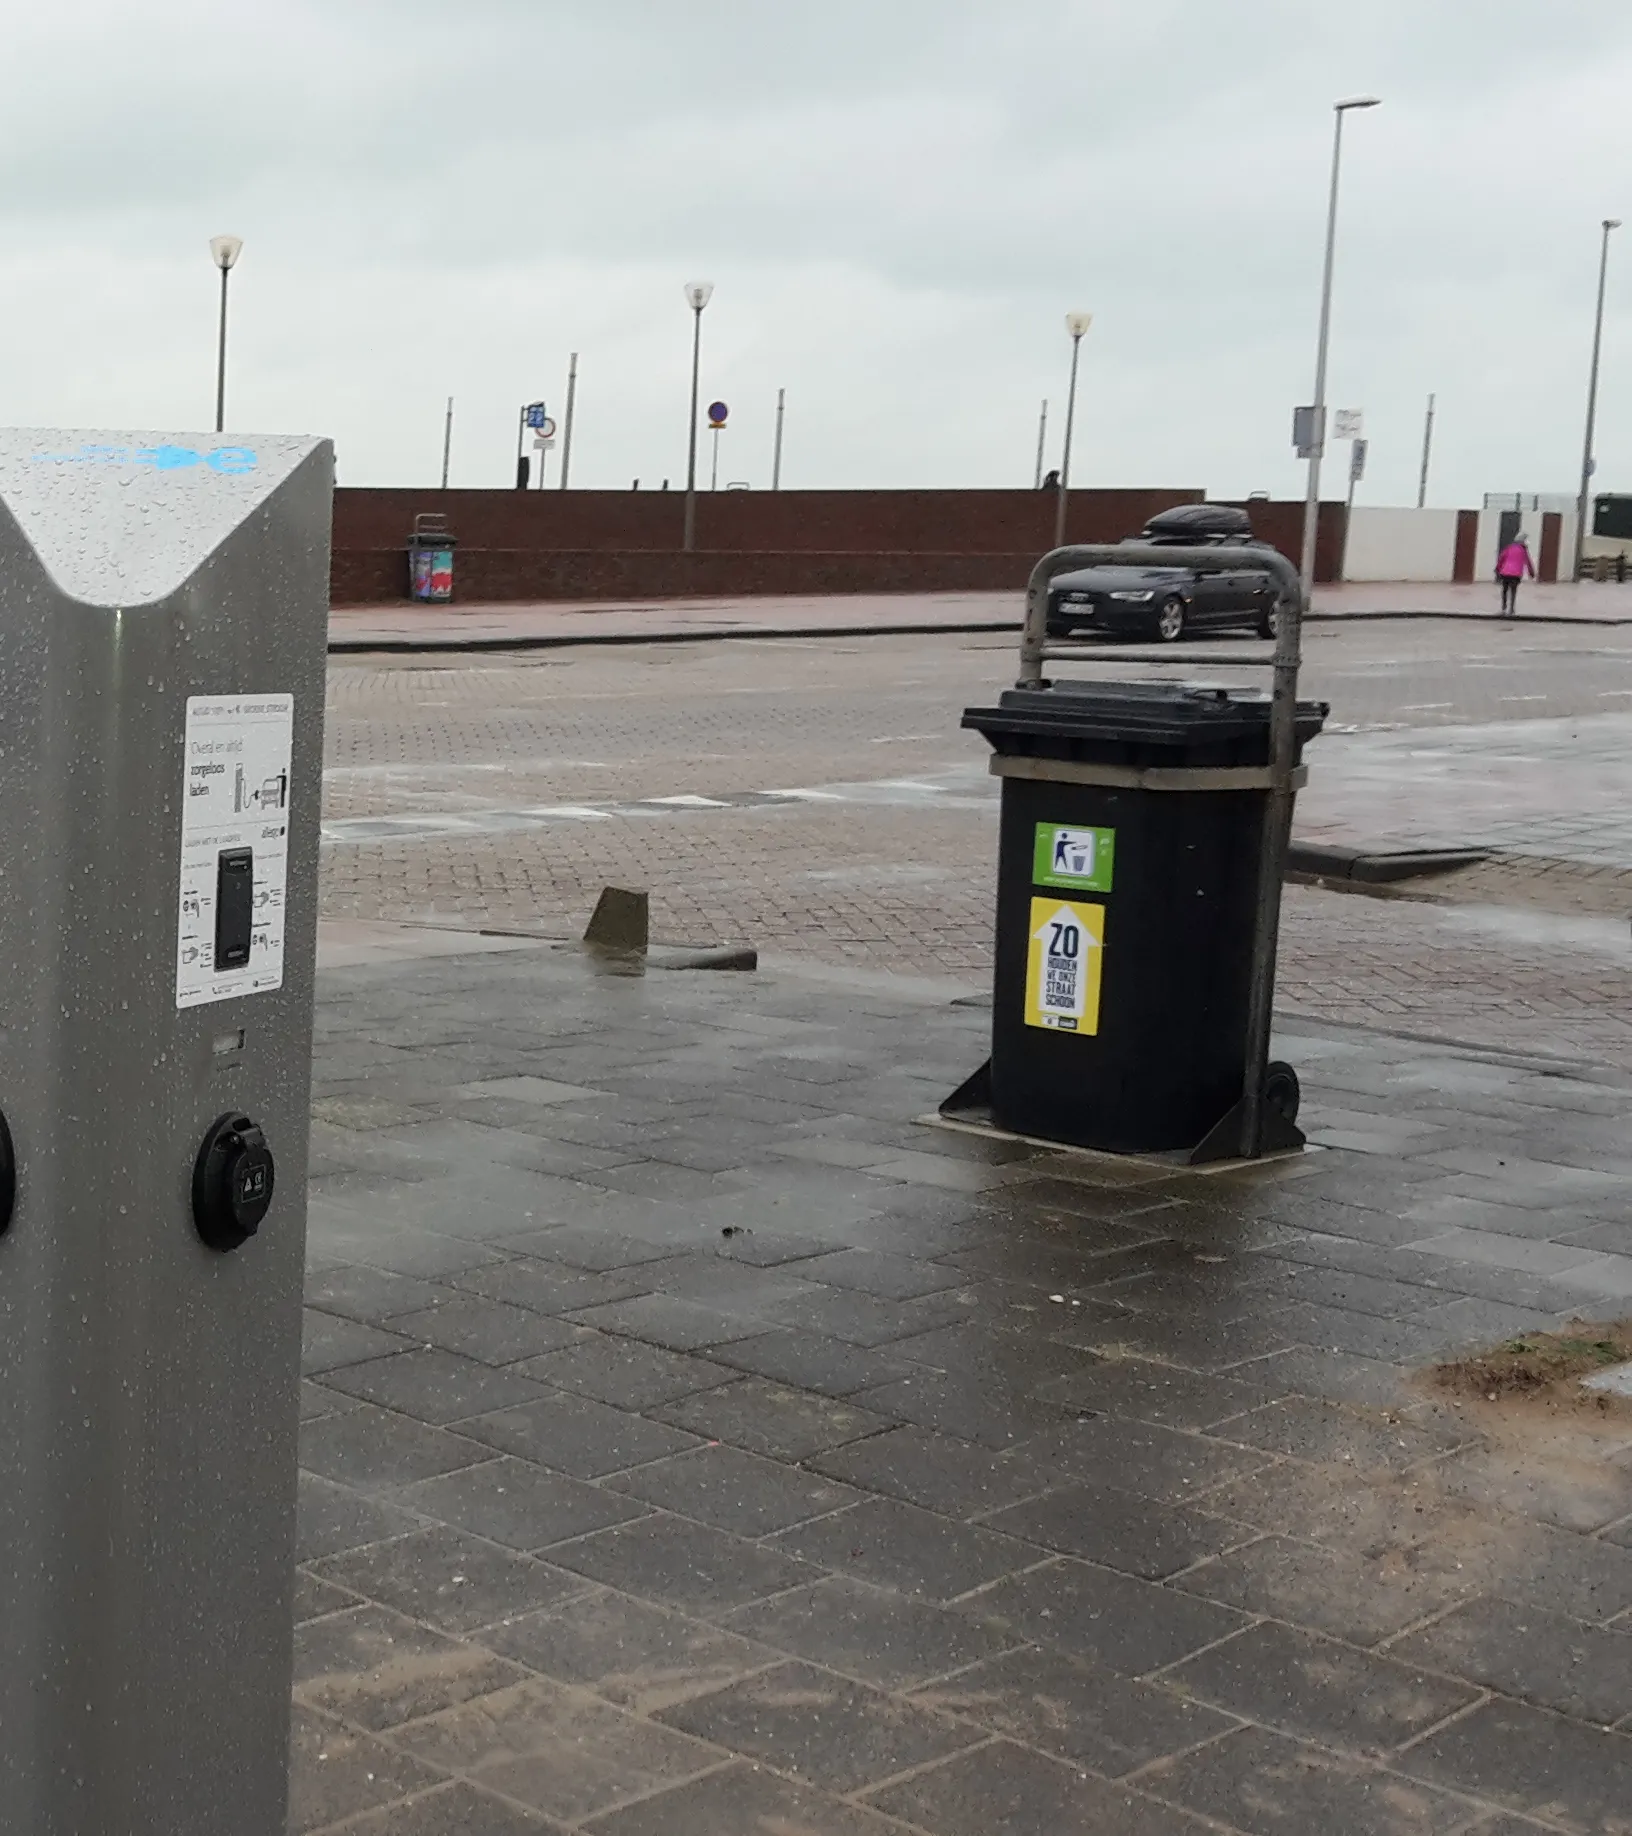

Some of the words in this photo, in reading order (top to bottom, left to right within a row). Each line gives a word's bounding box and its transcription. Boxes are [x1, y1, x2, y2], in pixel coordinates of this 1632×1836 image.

[189, 783, 210, 797] laden
[1049, 923, 1079, 958] ZO
[1048, 957, 1077, 971] HOUDEN
[1047, 970, 1057, 981] WE
[1046, 981, 1076, 996] STRAAT
[1046, 994, 1075, 1009] SCHOON
